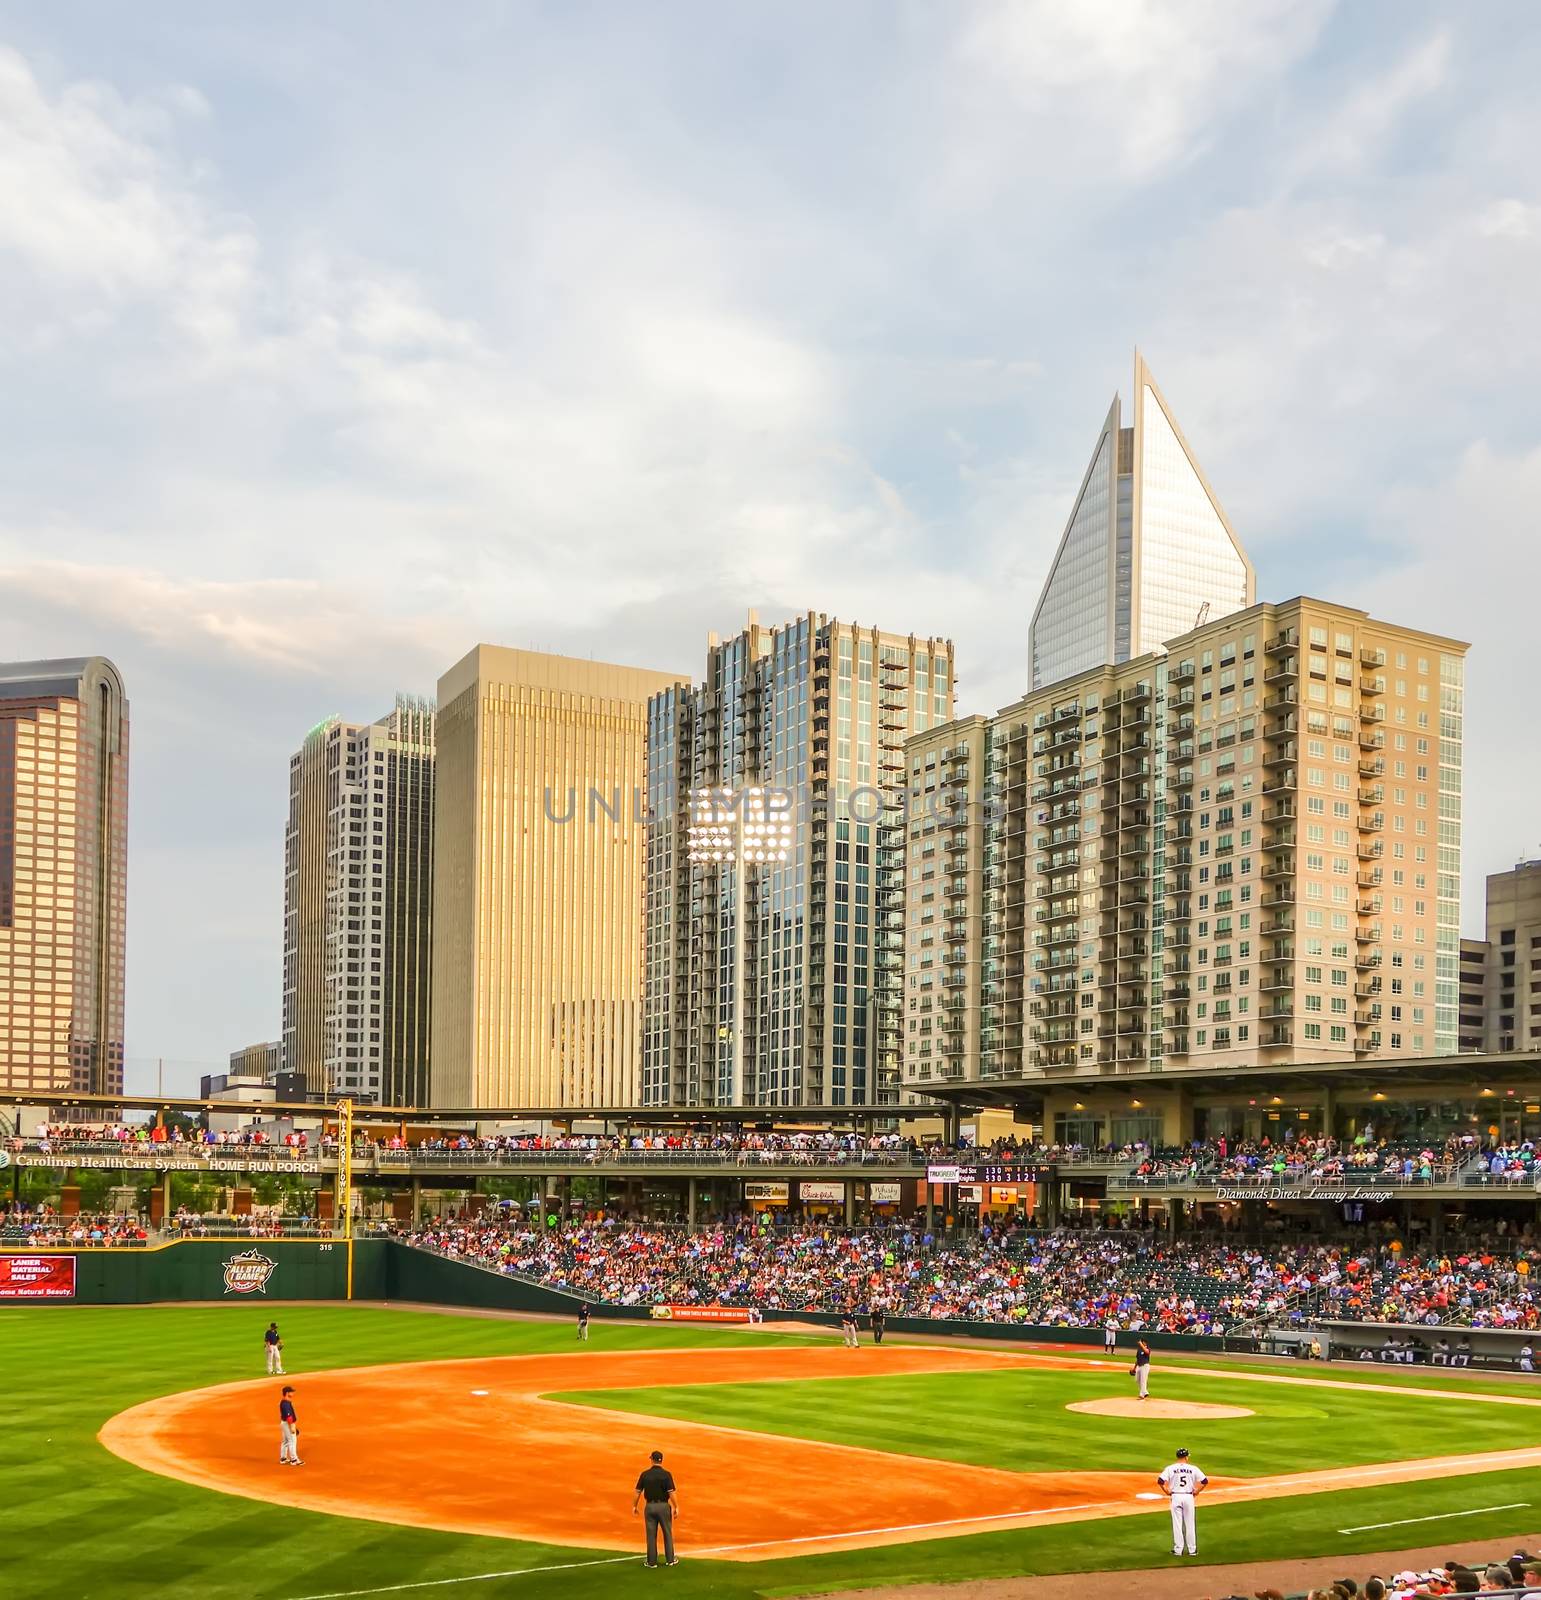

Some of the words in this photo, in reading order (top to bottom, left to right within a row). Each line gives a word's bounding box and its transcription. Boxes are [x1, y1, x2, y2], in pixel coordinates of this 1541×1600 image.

[15, 1155, 77, 1168] Carolinas
[80, 1157, 151, 1169] HealthCare
[155, 1158, 199, 1172] System
[209, 1160, 245, 1171] HOME
[249, 1161, 274, 1172] RUN
[277, 1162, 318, 1173] PORCH
[1006, 1174, 1011, 1182] 3
[1016, 1174, 1020, 1182] 1
[1024, 1174, 1028, 1182] 2
[1032, 1174, 1036, 1182] 1
[874, 1186, 898, 1195] Whisky
[1216, 1187, 1269, 1200] Diamonds
[1270, 1187, 1301, 1200] Direct
[1303, 1187, 1348, 1203] Luxury
[1348, 1186, 1394, 1203] Lounge
[230, 1265, 245, 1273] ALL
[246, 1265, 268, 1273] STAR
[1180, 1476, 1186, 1487] 5
